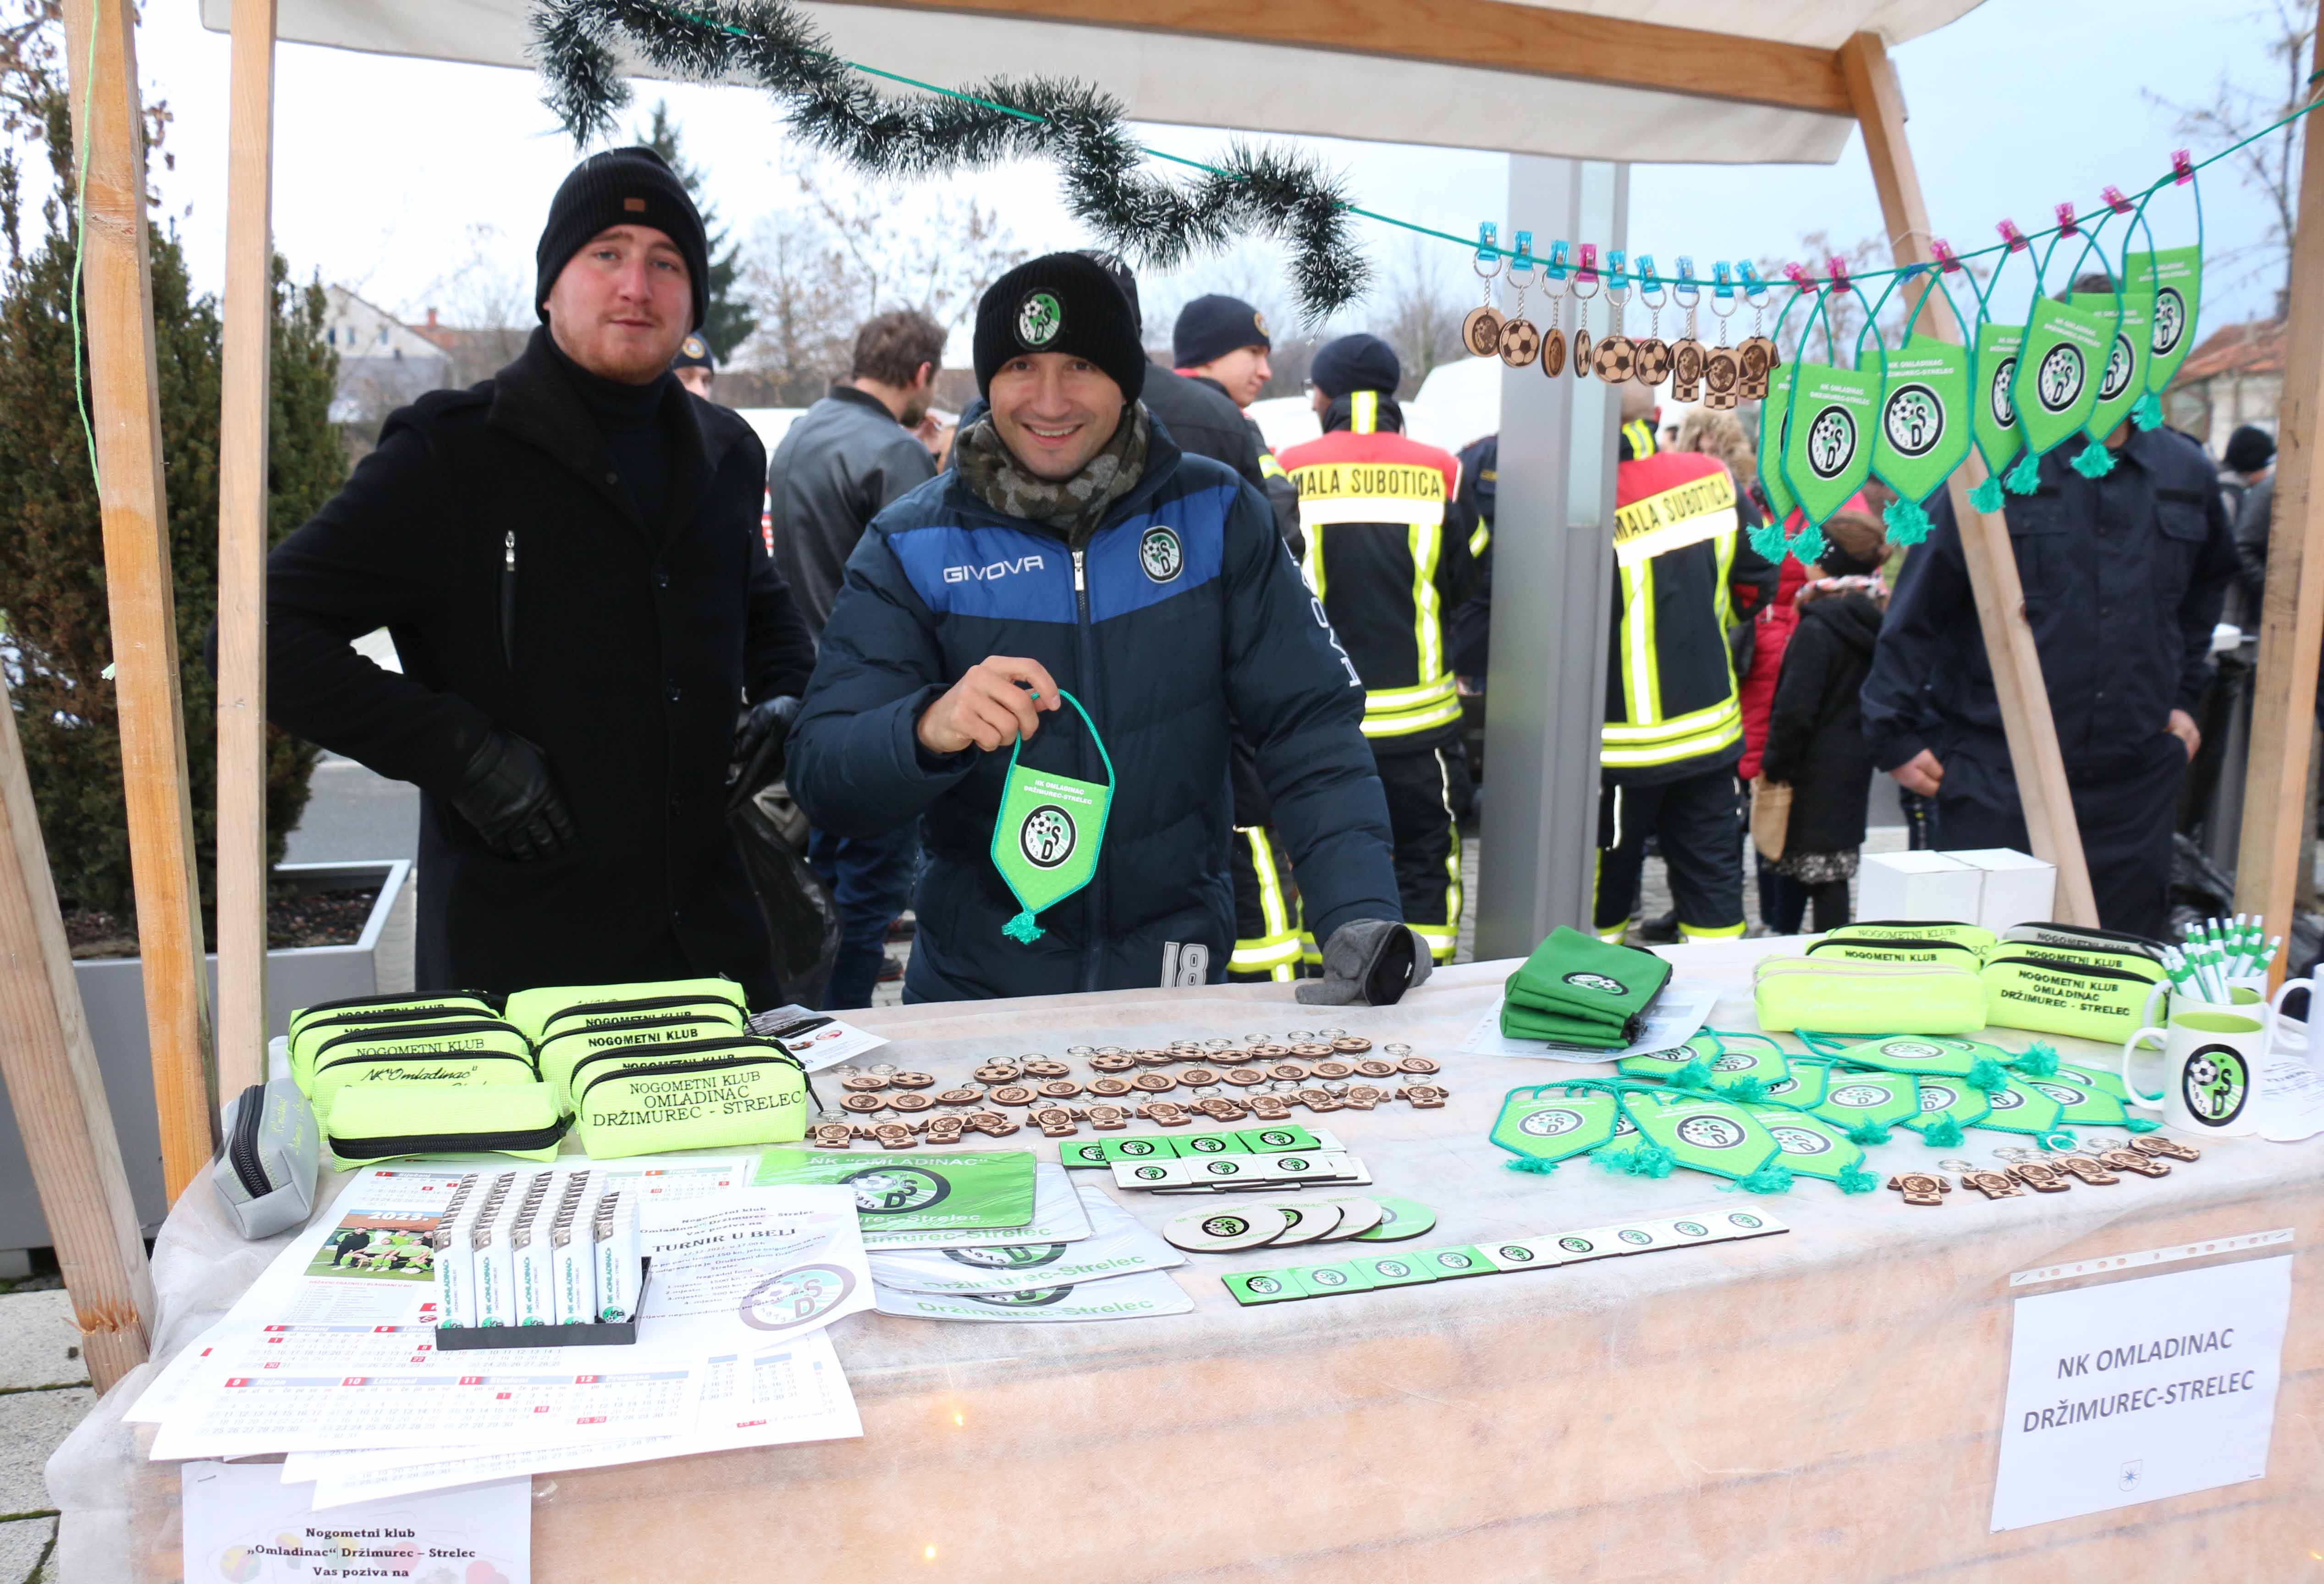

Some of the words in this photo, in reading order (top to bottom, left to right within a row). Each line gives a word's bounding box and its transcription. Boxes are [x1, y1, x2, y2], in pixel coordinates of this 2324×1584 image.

[1292, 470, 1341, 496] MALA
[1351, 469, 1441, 497] SUBOTICA
[1614, 503, 1661, 542] MALA
[943, 555, 1044, 583] GIVOVA
[1046, 781, 1085, 796] OMLADINAC
[1927, 928, 1956, 939] KLUB
[1161, 941, 1209, 988] 18
[1845, 950, 1905, 962] NOGOMETNI
[1910, 953, 1937, 962] KLUB
[2026, 949, 2090, 965] NOGOMETNI
[2094, 957, 2123, 968] KLUB
[2018, 970, 2085, 989] NOGOMETNI
[2090, 981, 2119, 992] KLUB
[2001, 989, 2068, 1008] DRŽIMUREC
[2079, 1002, 2131, 1016] STRELEC
[2033, 984, 2100, 1001] OMLADINAC
[588, 1034, 661, 1047] NOGOMETNI
[666, 1028, 699, 1041] KLUB
[356, 1044, 443, 1058] NOGOMETNI
[447, 1039, 485, 1053] KLUB
[630, 1077, 716, 1094] NOGOMETNI
[723, 1071, 760, 1087] KLUB
[644, 1085, 749, 1109] OMLADINAC
[593, 1106, 702, 1127] DRŽIMUREC
[723, 1090, 803, 1115] STRELEC
[810, 1157, 839, 1165] NK
[368, 1211, 429, 1221] 2023.
[652, 1235, 725, 1253] TURNIR
[750, 1228, 797, 1238] BELI
[920, 1254, 1146, 1291] Držimurec-Strelec
[917, 1298, 1155, 1318] Držimurec-Strelec
[2057, 1353, 2091, 1380] NK
[2095, 1328, 2235, 1372] OMLADINAC
[2022, 1369, 2255, 1433] DRŽIMUREC-STRELEC
[305, 1528, 381, 1540] Nogometni
[384, 1528, 416, 1539] klub
[341, 1546, 414, 1559] Držimurec
[429, 1547, 476, 1559] Strelec
[313, 1567, 338, 1577] Vas
[341, 1566, 389, 1579] poziva
[392, 1568, 409, 1577] na
